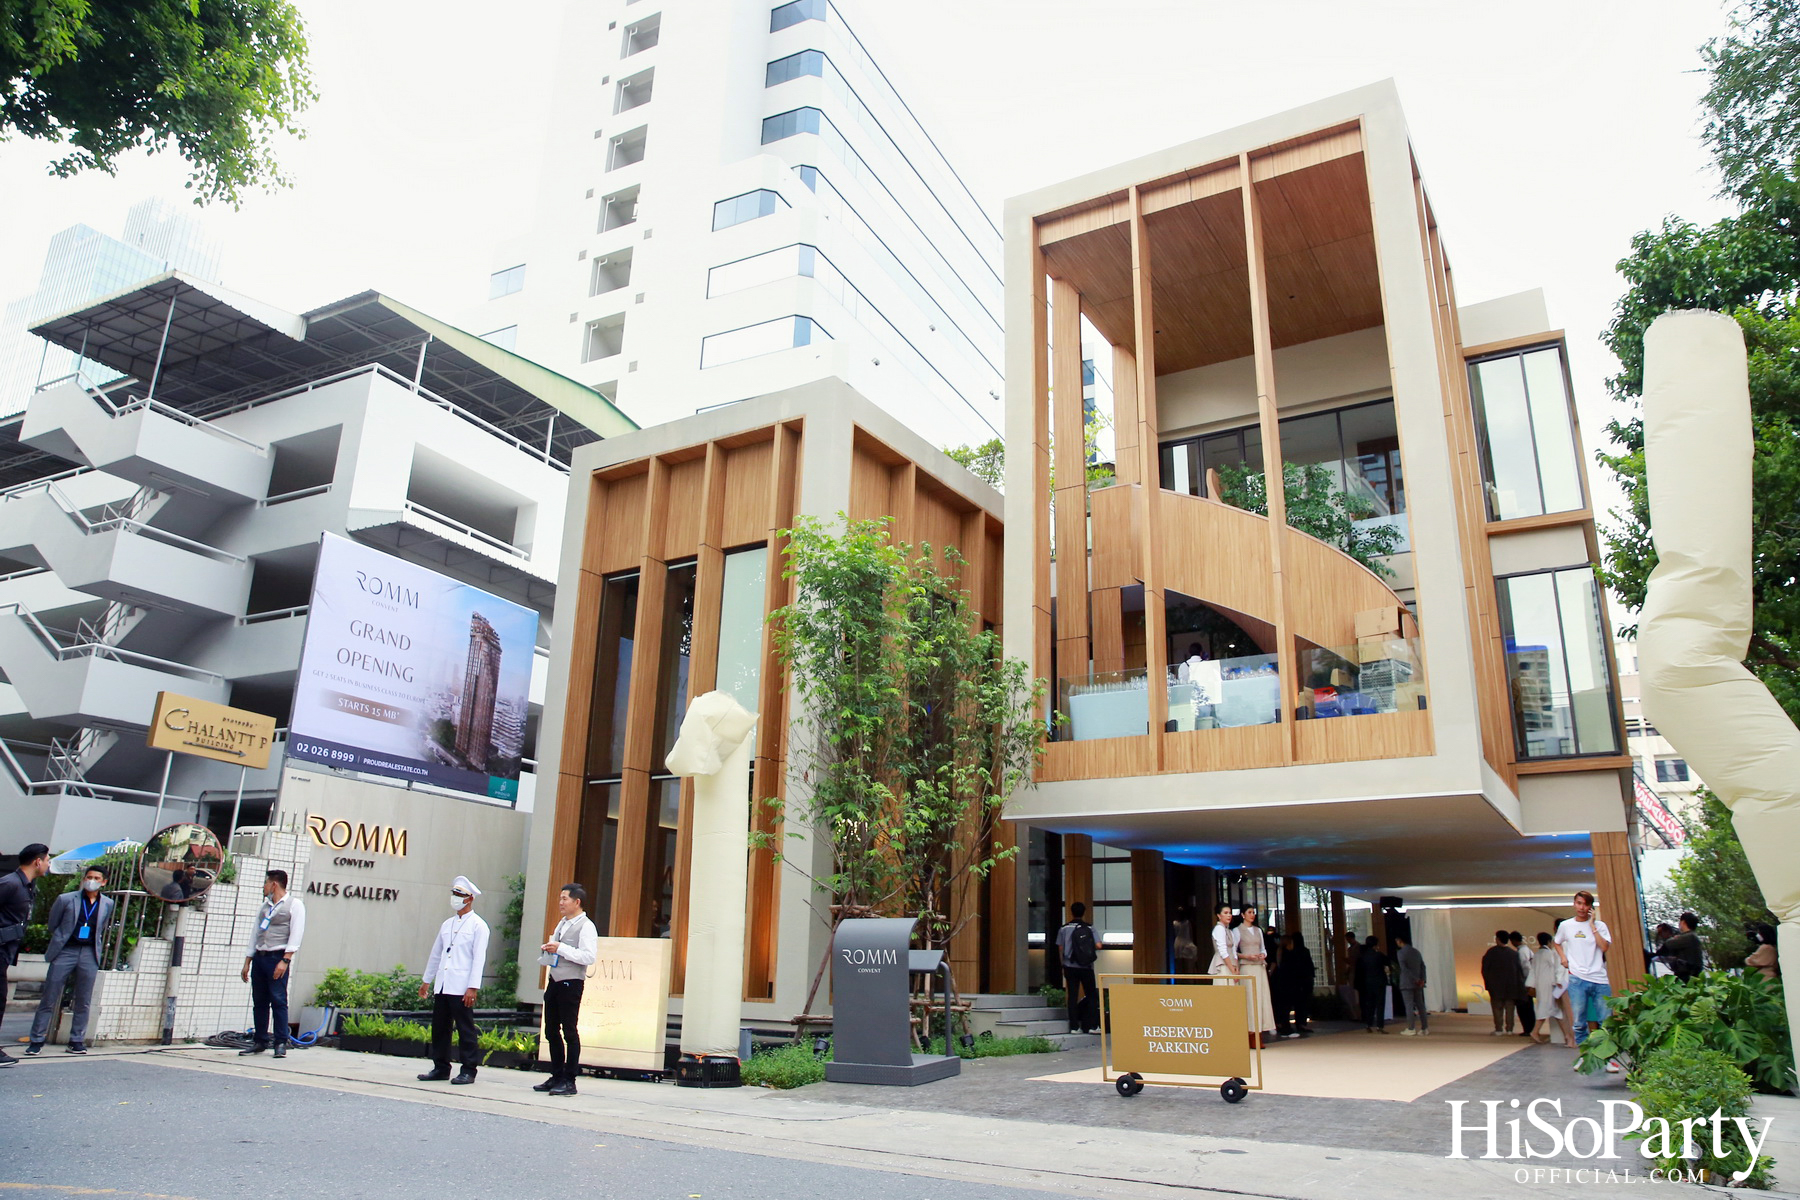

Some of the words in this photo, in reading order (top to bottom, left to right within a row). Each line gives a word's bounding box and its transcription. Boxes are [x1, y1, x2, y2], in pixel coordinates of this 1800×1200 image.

[356, 570, 419, 609] ROMM
[371, 599, 399, 613] CONVENT
[350, 619, 411, 651] GRAND
[336, 647, 414, 683] OPENING
[312, 668, 325, 678] GET
[330, 674, 347, 684] SEATS
[338, 697, 370, 713] STARTS
[371, 707, 381, 717] 15
[196, 737, 235, 750] BUILDING
[259, 736, 268, 749] P
[296, 742, 309, 753] 02
[311, 745, 329, 758] 026
[331, 750, 355, 763] 8999
[363, 757, 429, 776] PROUDREALESTATE.CO.TH
[309, 815, 408, 857] ROMM
[333, 856, 376, 869] CONVENT
[306, 880, 340, 897] ALES
[343, 884, 400, 902] GALLERY
[842, 949, 898, 965] ROMM
[1159, 998, 1193, 1008] ROMM
[1143, 1025, 1214, 1039] RESERVED
[1148, 1041, 1210, 1055] PARKING
